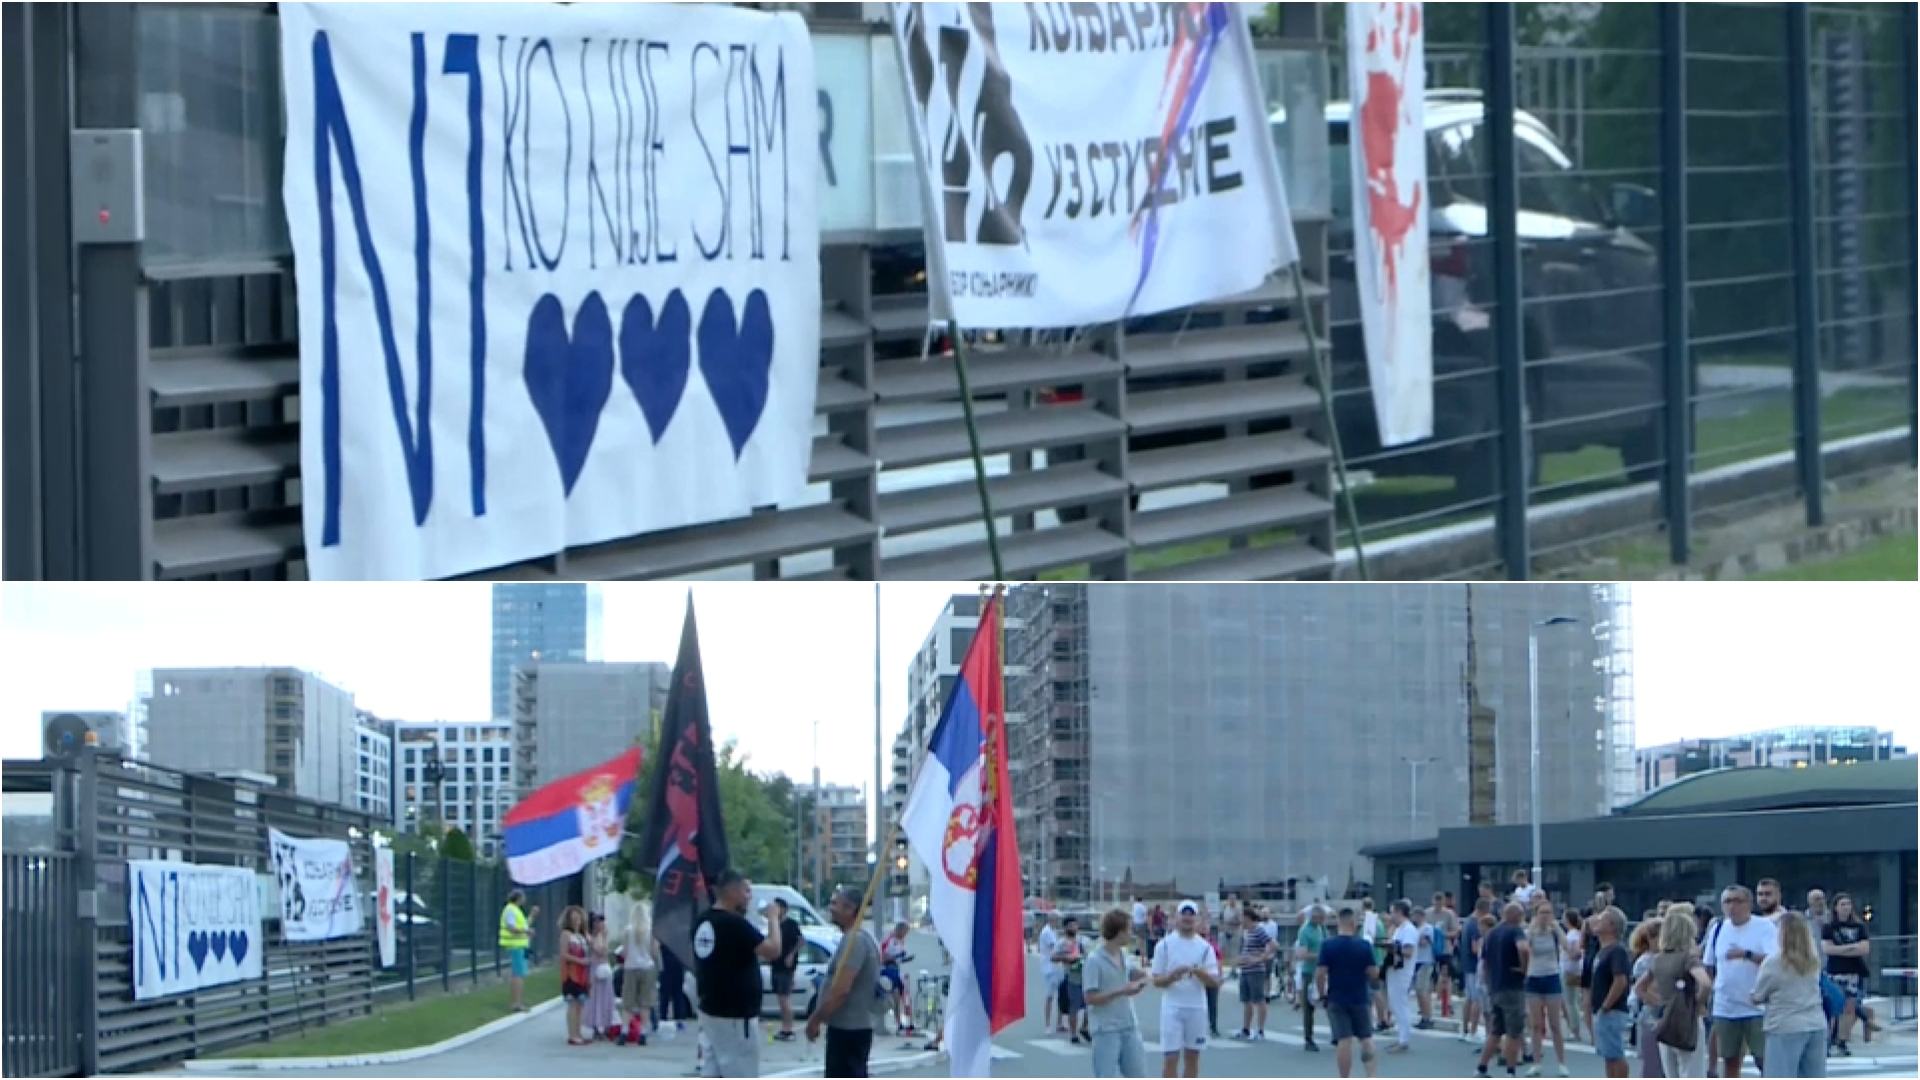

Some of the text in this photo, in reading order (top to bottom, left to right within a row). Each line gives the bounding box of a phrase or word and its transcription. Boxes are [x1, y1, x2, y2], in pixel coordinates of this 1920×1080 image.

[311, 29, 791, 548] N1 KO NIJE SAM
[137, 870, 180, 987] N1
